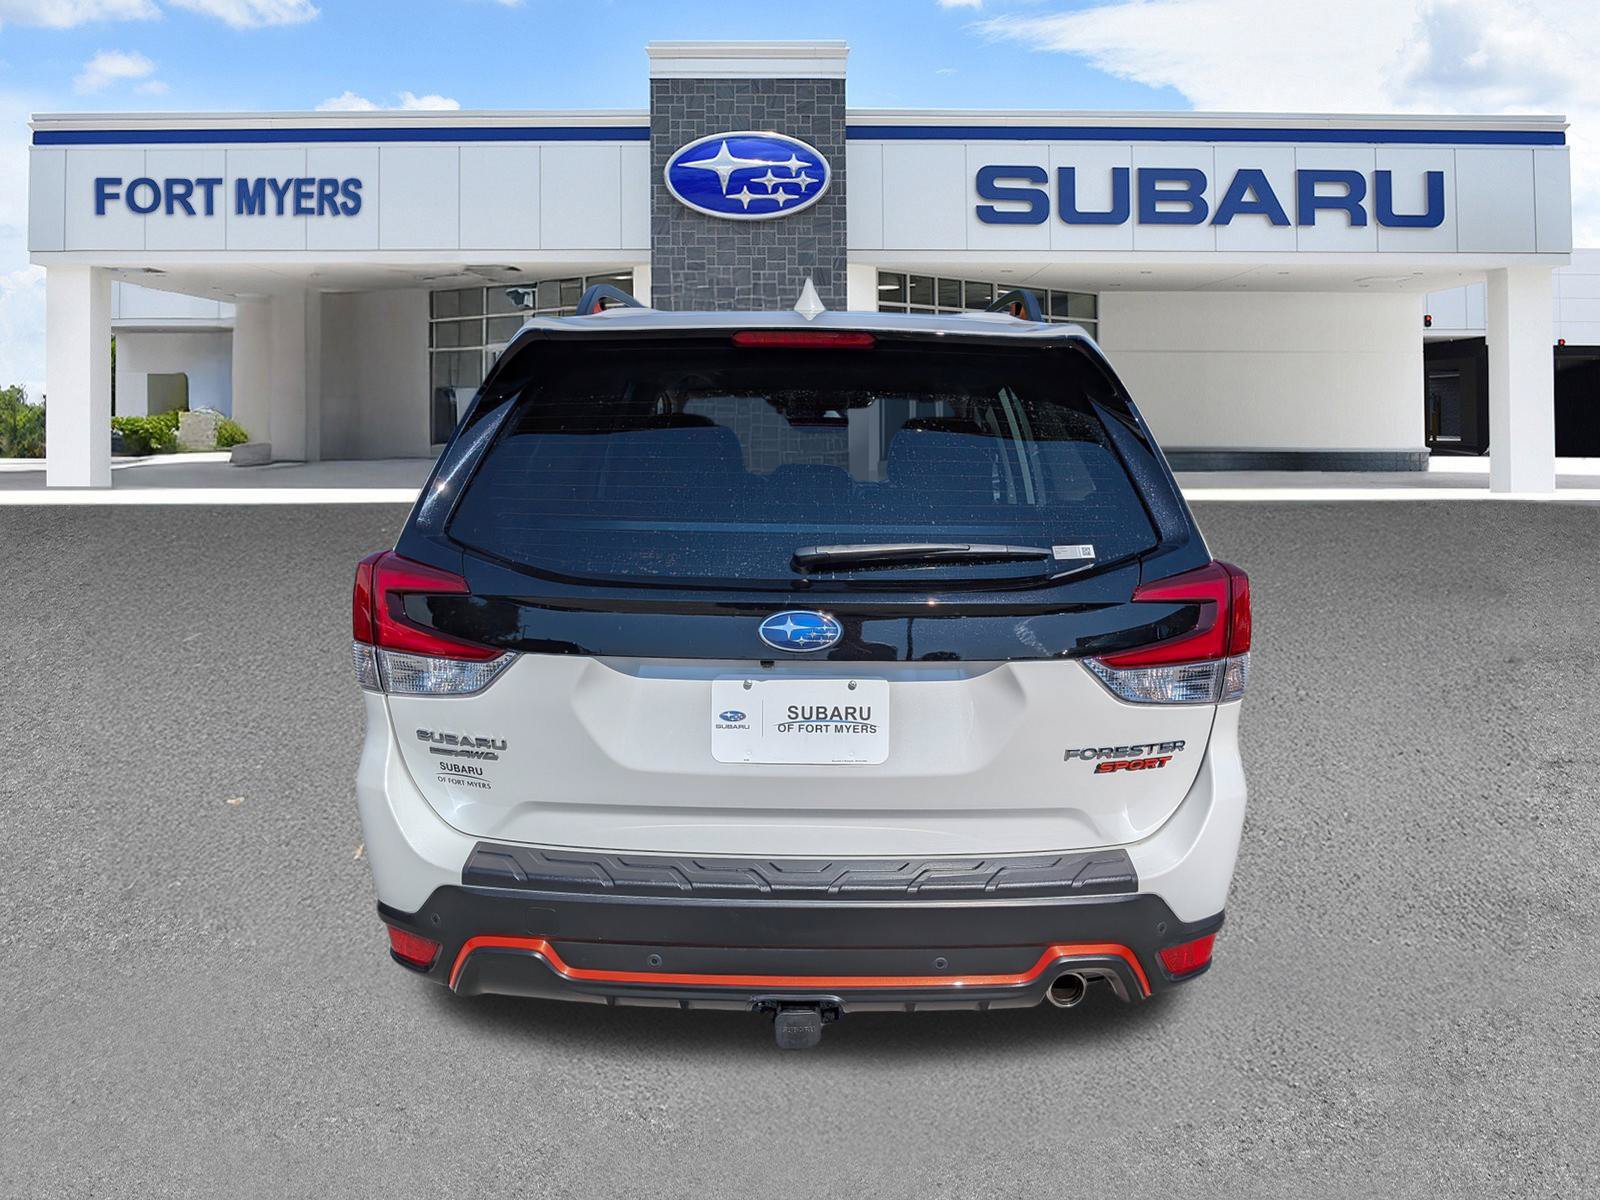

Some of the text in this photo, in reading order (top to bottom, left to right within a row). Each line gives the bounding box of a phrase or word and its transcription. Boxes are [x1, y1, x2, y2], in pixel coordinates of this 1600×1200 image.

[95, 177, 363, 217] FORT MYERS
[976, 165, 1445, 229] SUBARU
[787, 705, 872, 721] SUBARU
[777, 723, 877, 734] OF FORT MYERS
[416, 729, 507, 750] SUBARU
[1064, 740, 1186, 761] FORESTER
[440, 761, 483, 775] SUBARU
[1094, 756, 1173, 774] SPORT
[448, 778, 465, 786] FORT
[467, 781, 492, 789] MYERS
